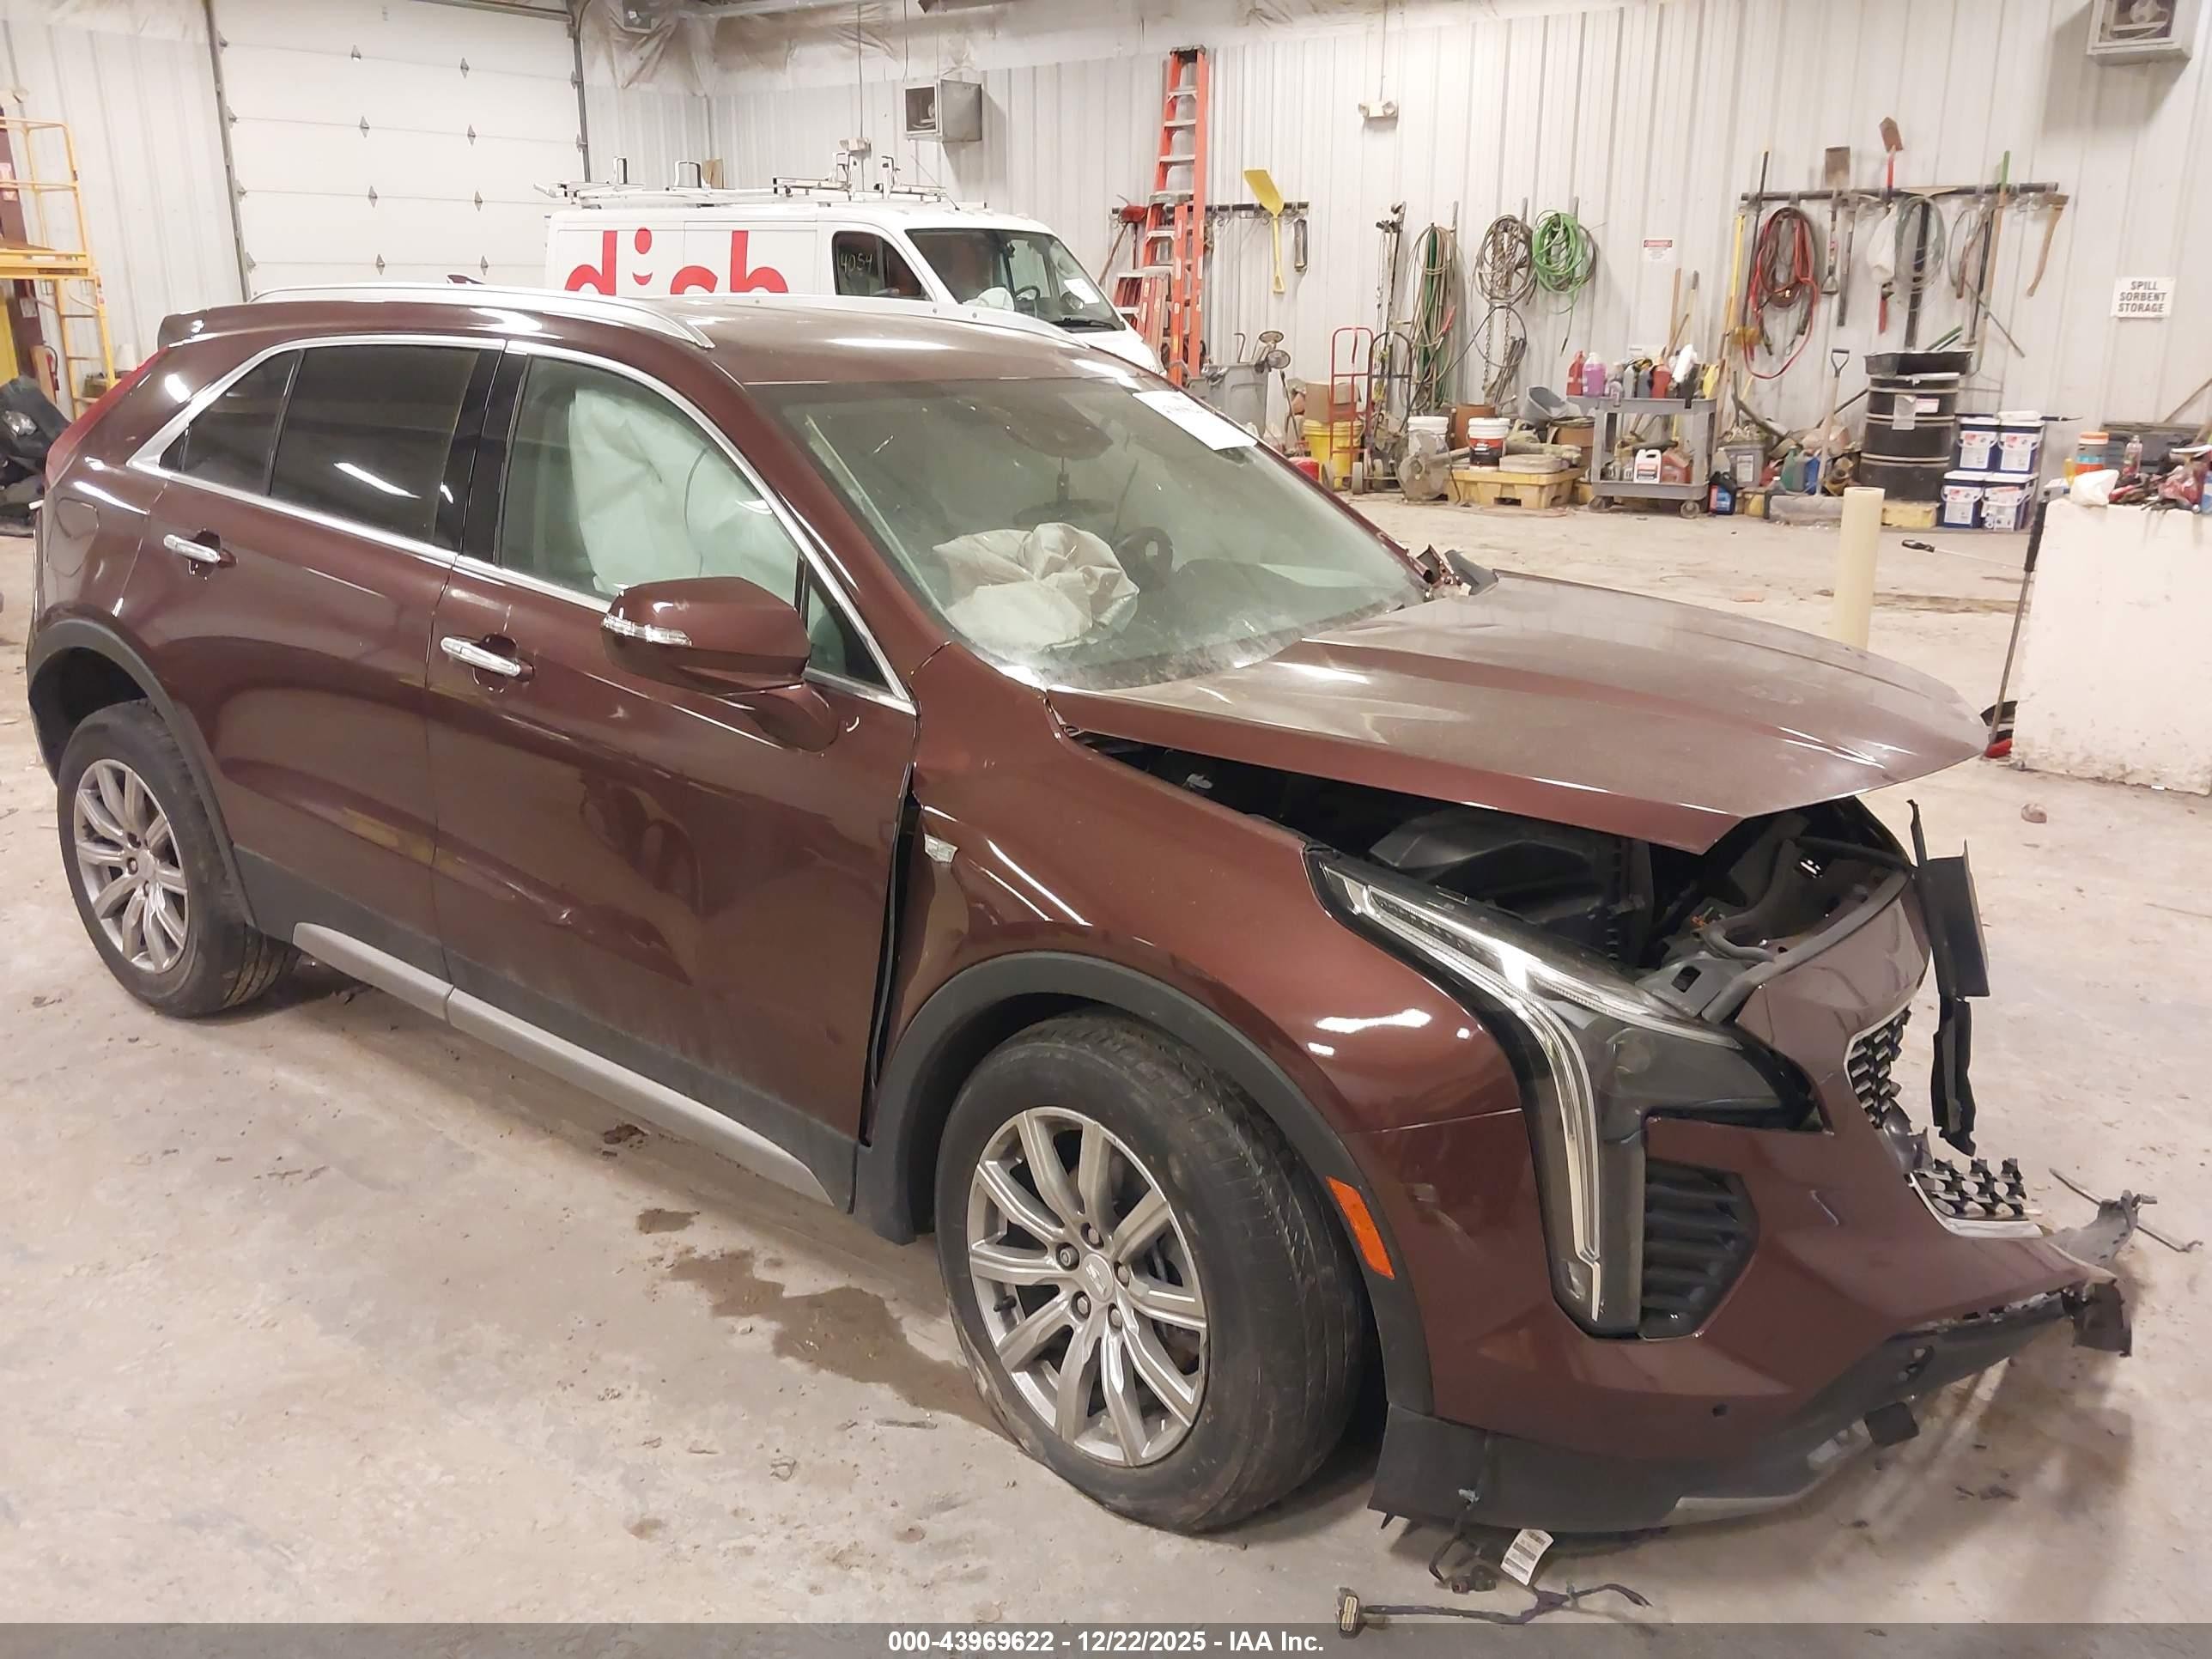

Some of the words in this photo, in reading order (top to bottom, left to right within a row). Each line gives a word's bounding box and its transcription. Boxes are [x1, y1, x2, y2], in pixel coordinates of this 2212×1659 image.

[2130, 281, 2158, 290] SPILL
[2119, 292, 2166, 301] SORBENT
[2118, 303, 2164, 313] STORAGE
